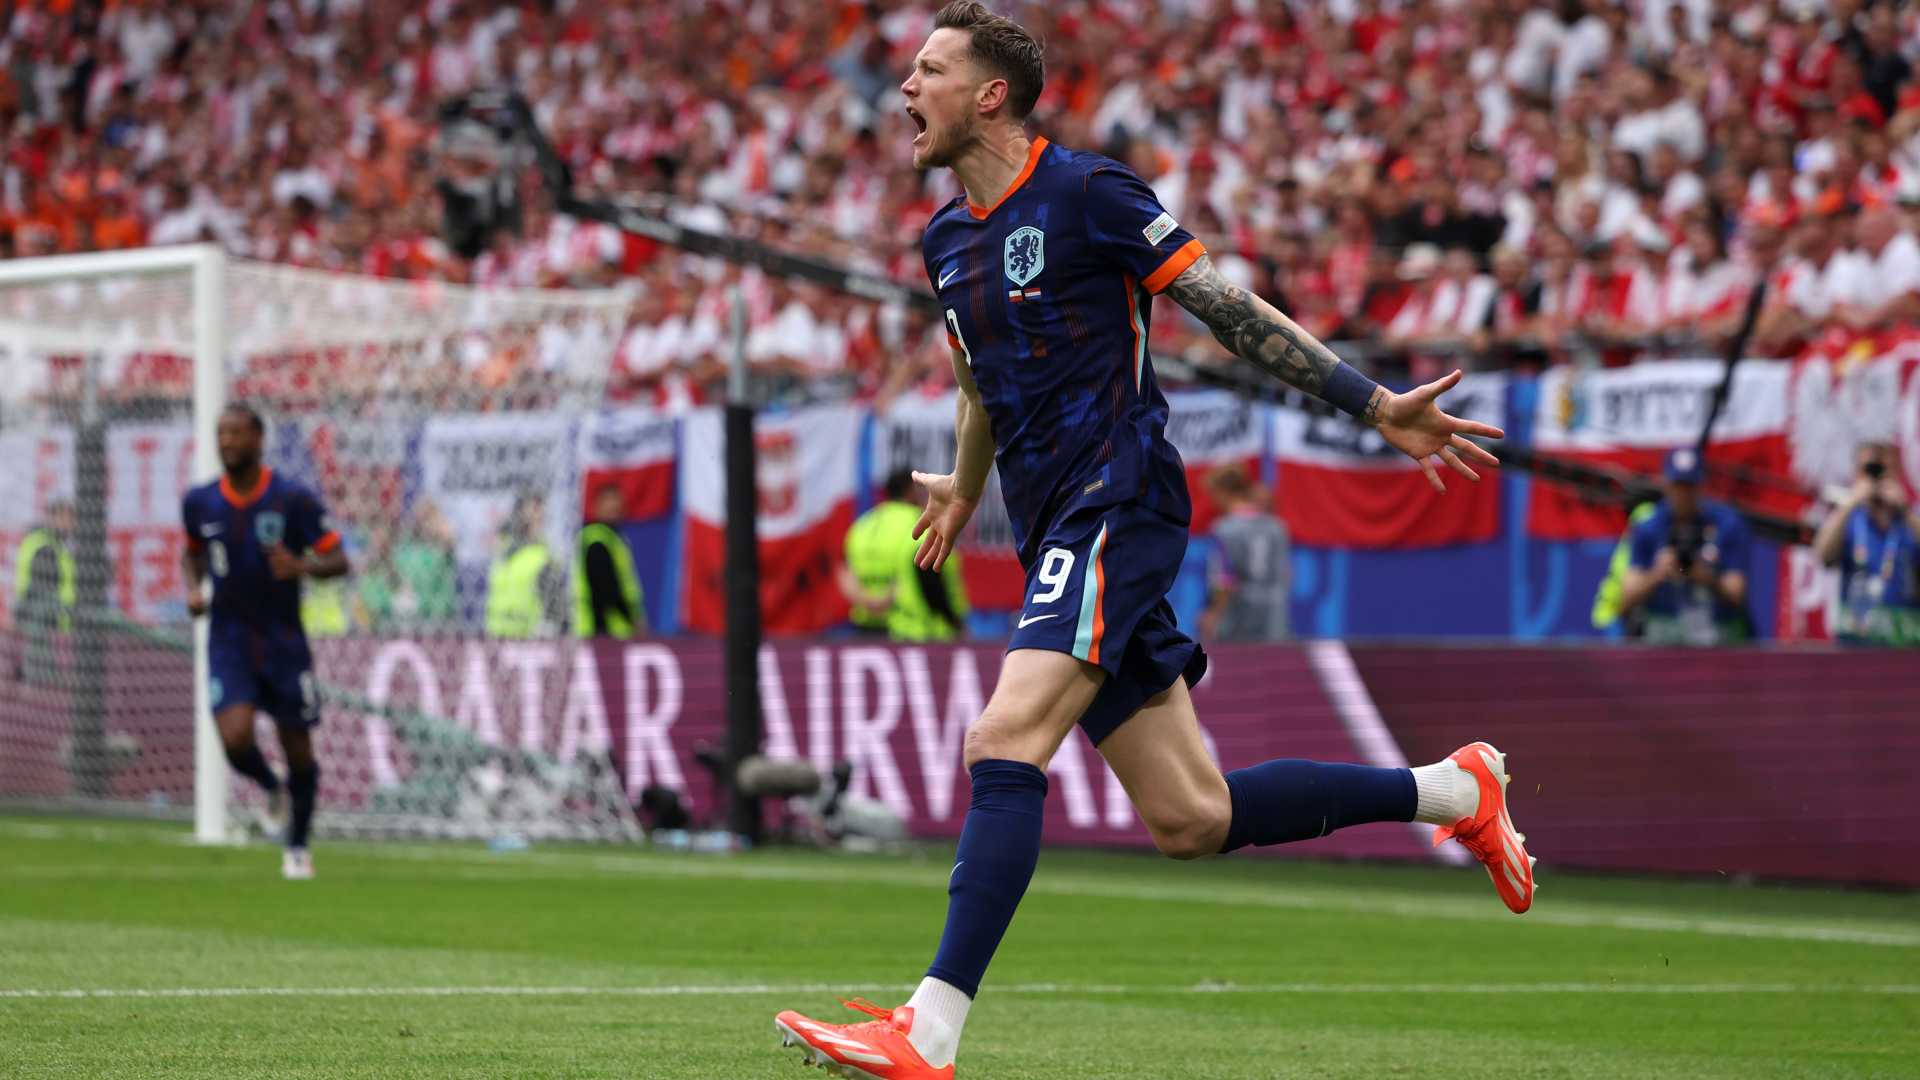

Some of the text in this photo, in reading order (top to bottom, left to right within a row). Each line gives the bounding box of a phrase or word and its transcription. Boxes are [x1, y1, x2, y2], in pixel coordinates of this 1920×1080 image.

[1032, 547, 1076, 604] 9
[366, 641, 1218, 828] QATAR AIRW
